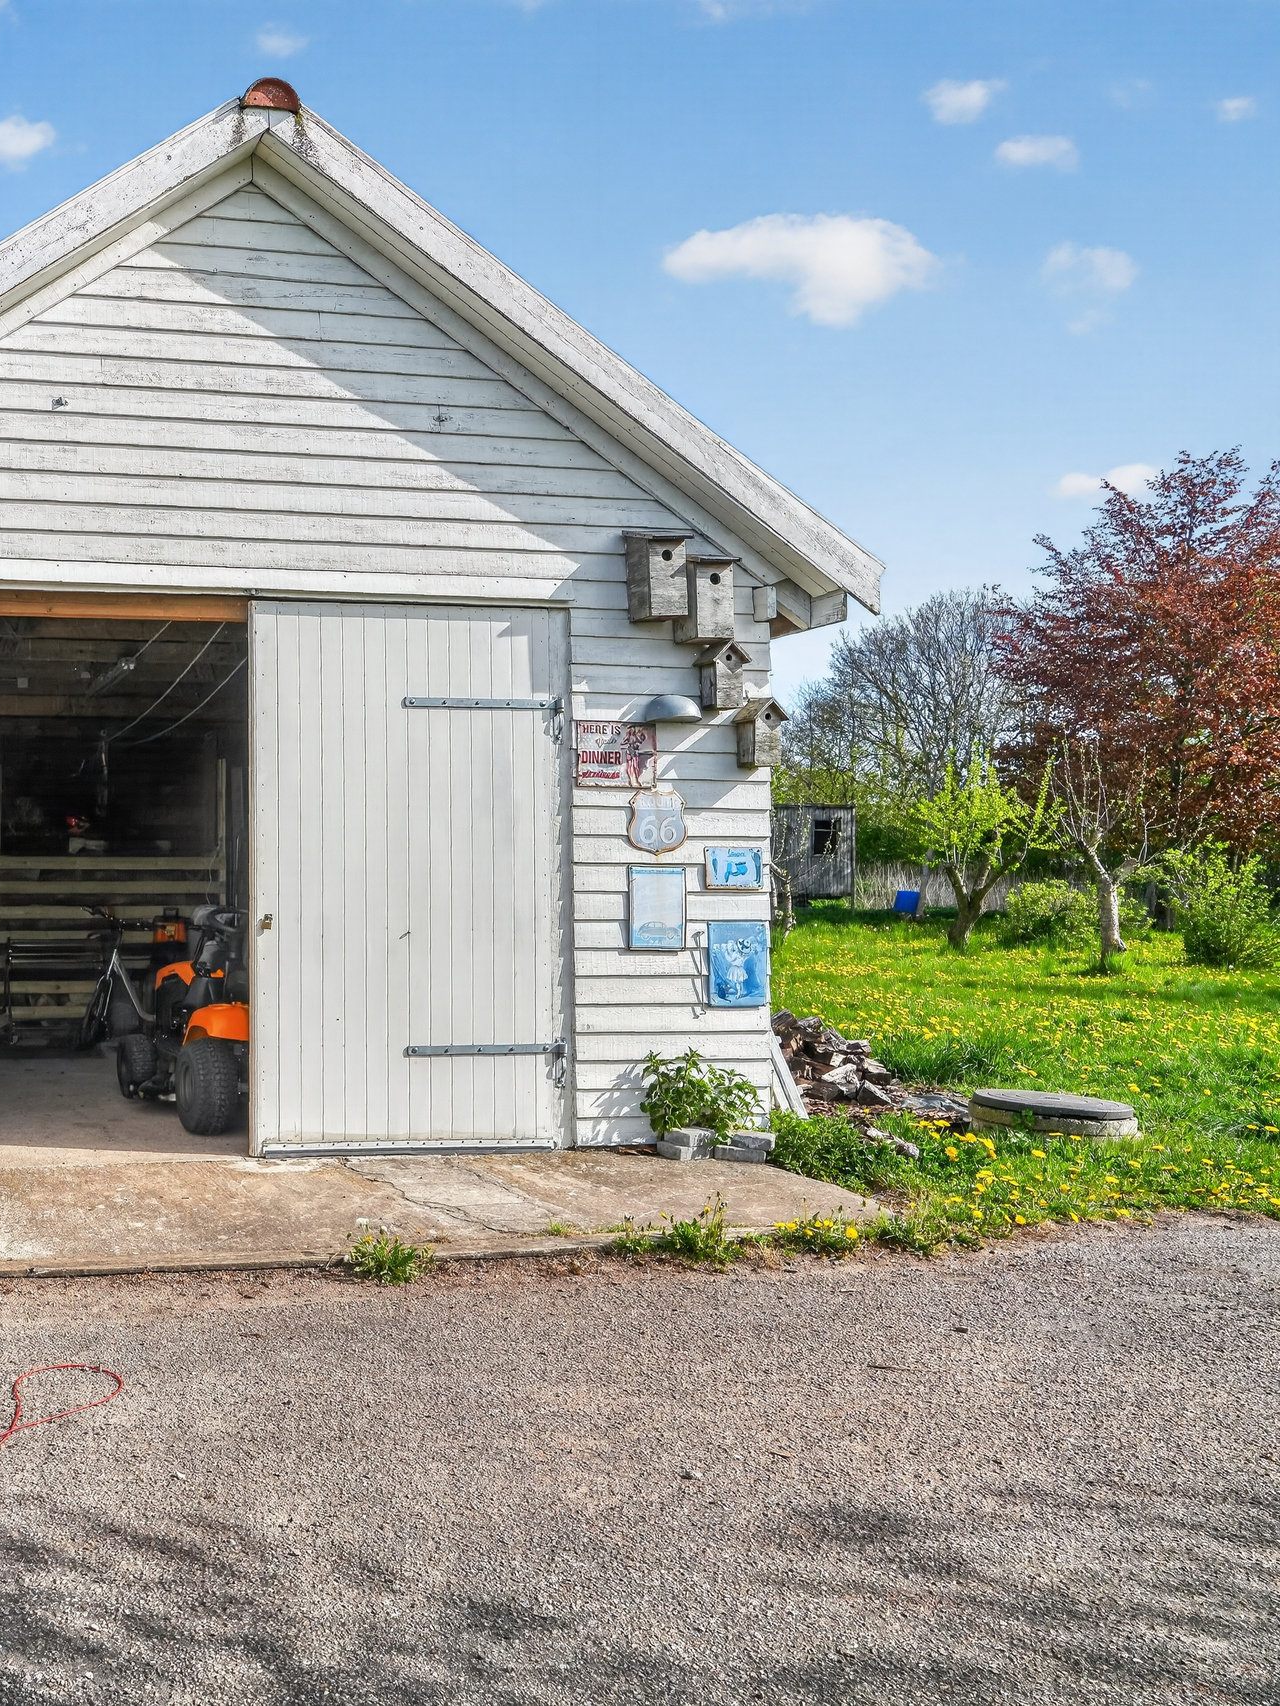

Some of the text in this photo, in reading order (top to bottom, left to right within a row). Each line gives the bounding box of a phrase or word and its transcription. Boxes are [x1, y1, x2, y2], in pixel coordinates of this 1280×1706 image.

[582, 724, 621, 736] HERE IS
[581, 750, 621, 765] DINNER
[639, 815, 677, 844] 66
